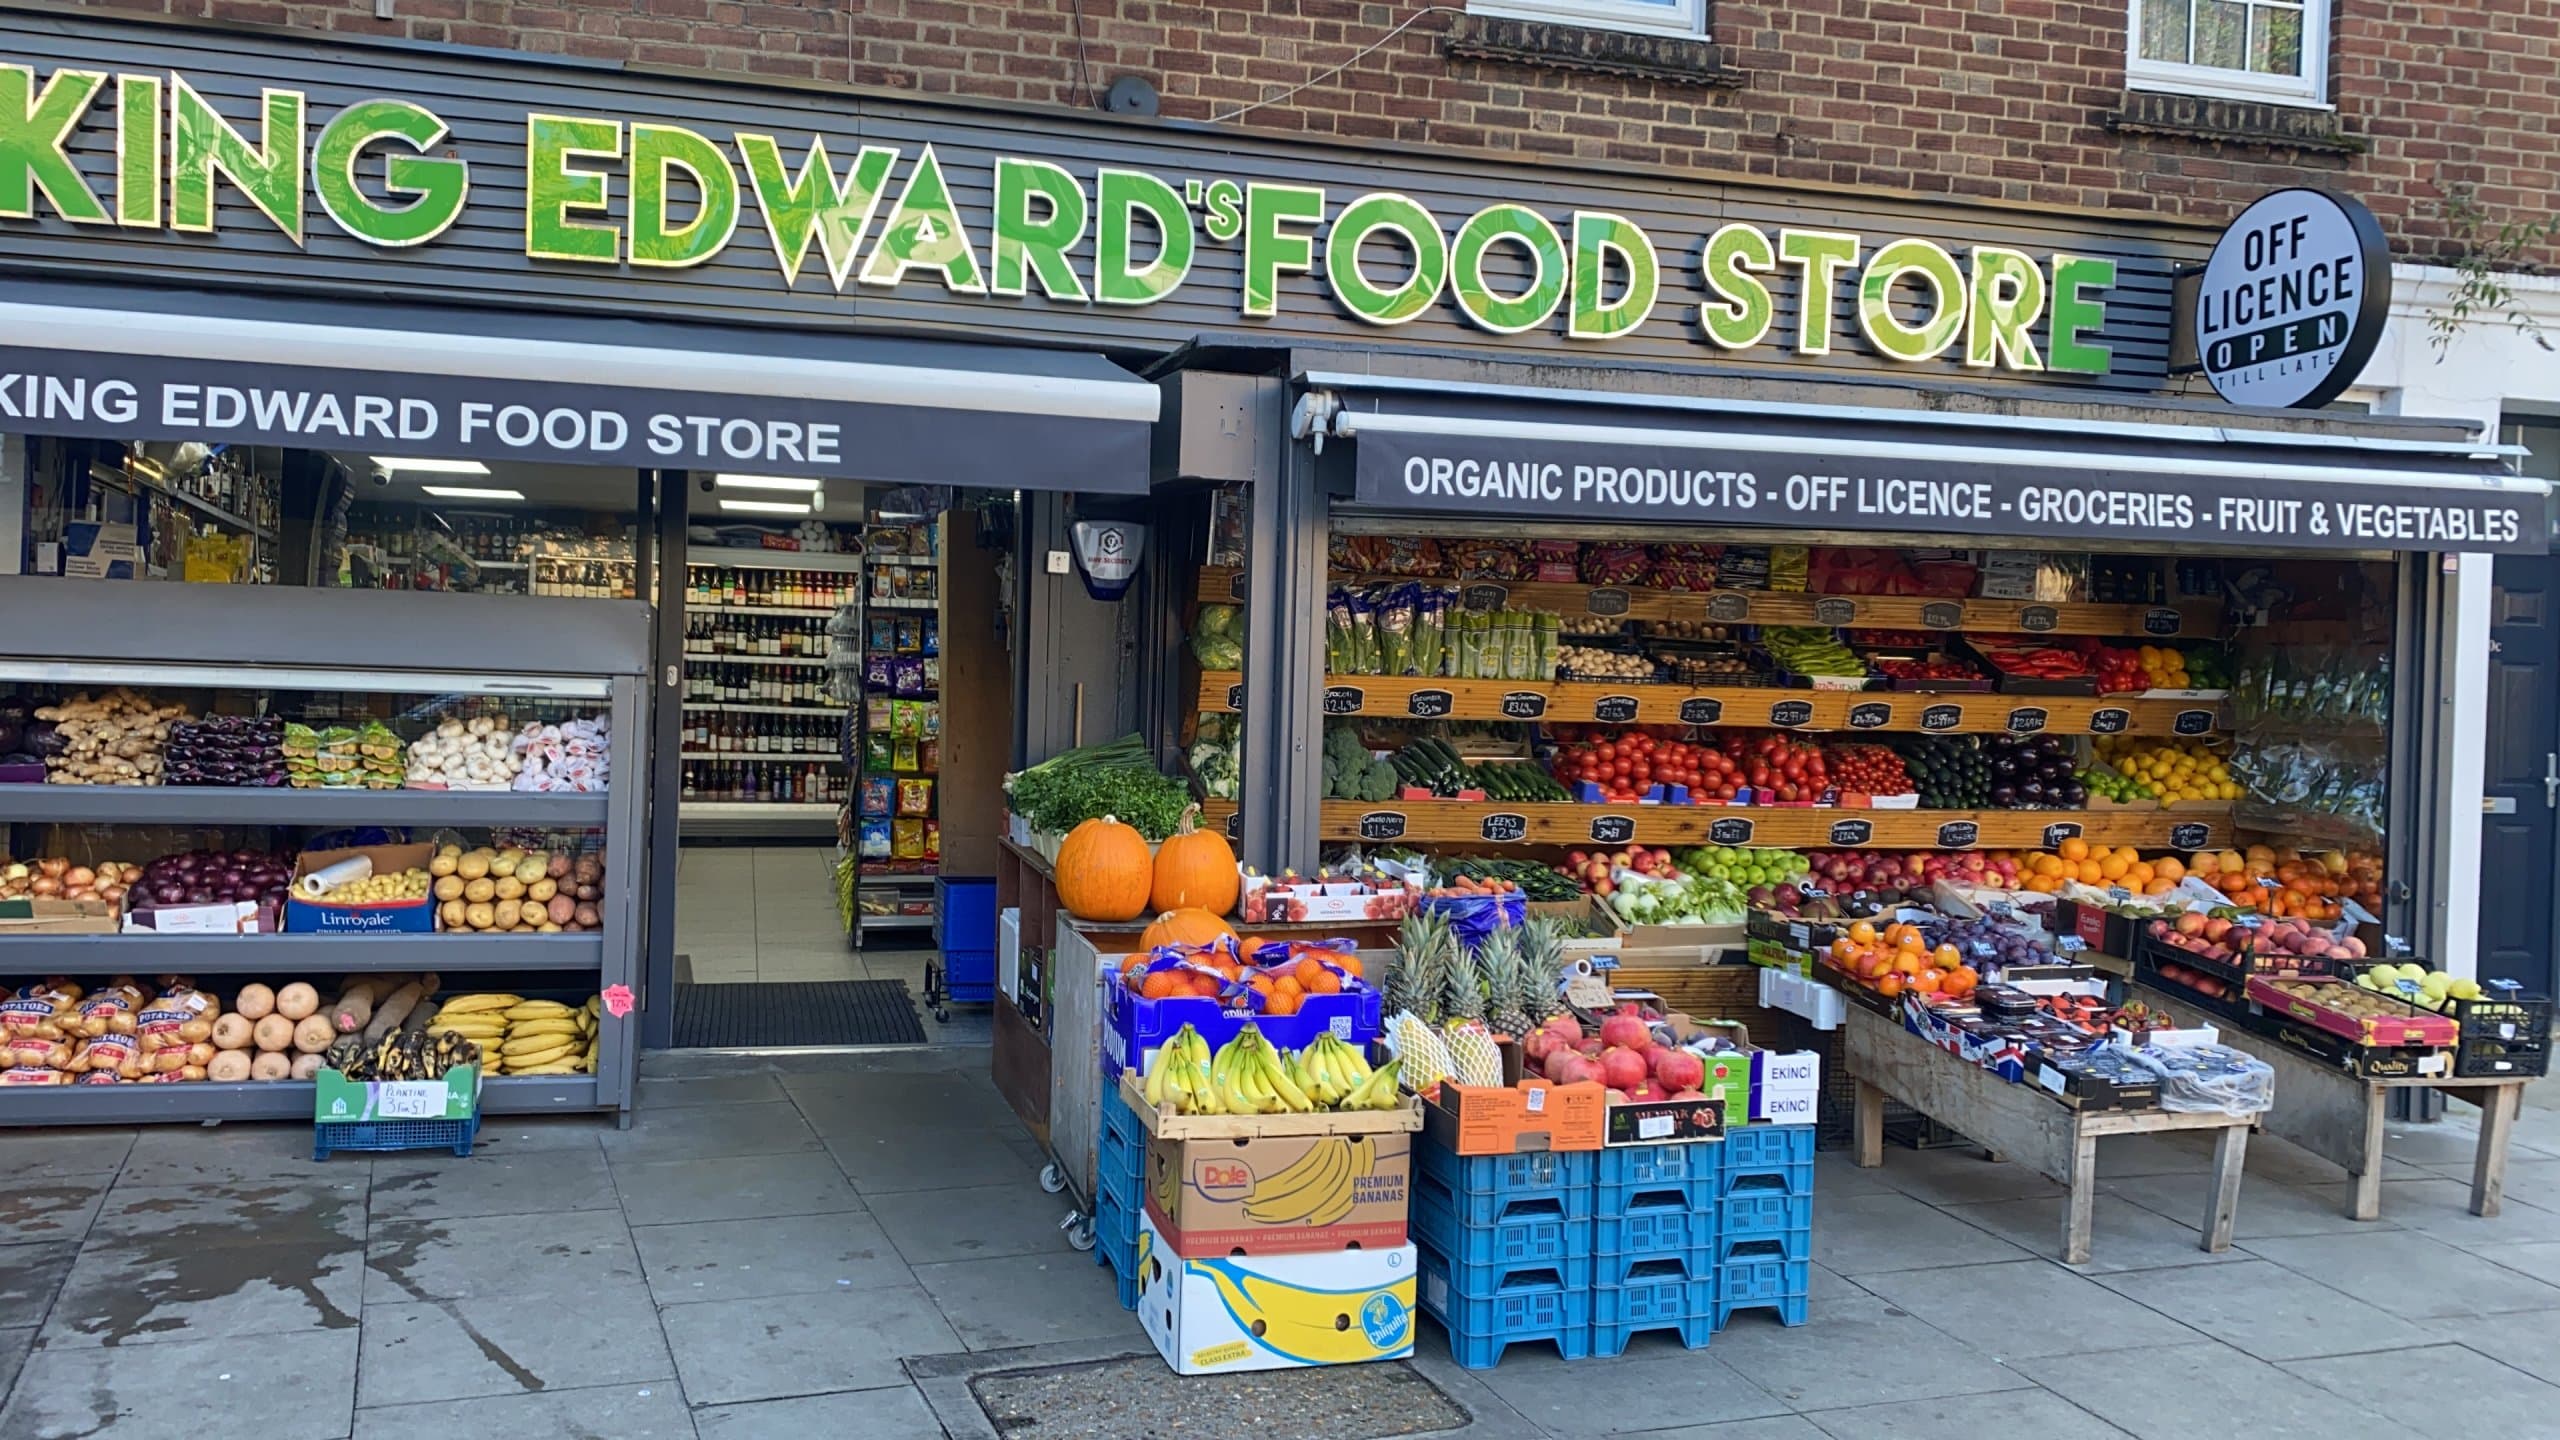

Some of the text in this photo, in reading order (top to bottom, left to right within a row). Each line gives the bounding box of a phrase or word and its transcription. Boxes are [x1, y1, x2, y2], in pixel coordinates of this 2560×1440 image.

[0, 63, 470, 248] KING
[1242, 182, 1660, 341] FOOD
[1700, 222, 2117, 375] STORE
[2244, 214, 2309, 272] OFF
[2203, 255, 2354, 335] LICENCE
[2217, 316, 2336, 369] OPEN
[2217, 351, 2336, 389] TILL LATE
[0, 373, 841, 464] KING EDWARD FOOD STORE
[1404, 456, 1563, 501] ORGANIC
[1573, 465, 1757, 509] PRODUCTS
[1785, 474, 1849, 512] OFF
[1857, 478, 1992, 519] LICENCE
[2018, 486, 2194, 529] GROCERIES
[2219, 497, 2303, 534] FRUIT
[2309, 501, 2330, 536] &
[2335, 503, 2520, 543] VEGETABLES
[1487, 816, 1517, 828] LEEKS
[321, 911, 392, 929] Linroyale
[0, 1002, 50, 1013] OTATOES
[1771, 1063, 1811, 1080] EKİNCİ
[2369, 1060, 2409, 1074] Quality
[1769, 1099, 1809, 1114] EKİNCİ
[1204, 1165, 1248, 1185] Dole
[1353, 1174, 1404, 1190] PREMIUM
[1352, 1189, 1404, 1204] BANANAS
[1185, 1235, 1219, 1246] PREMIUM
[1220, 1234, 1254, 1245] BANANAS
[1262, 1231, 1296, 1242] PREMIUM
[1296, 1231, 1329, 1240] BANANAS
[1337, 1228, 1370, 1238] PREMIUM
[1370, 1226, 1402, 1237] BANANAS
[1369, 1310, 1409, 1346] Chiquita
[1200, 1350, 1246, 1367] CLASS EXTRA
